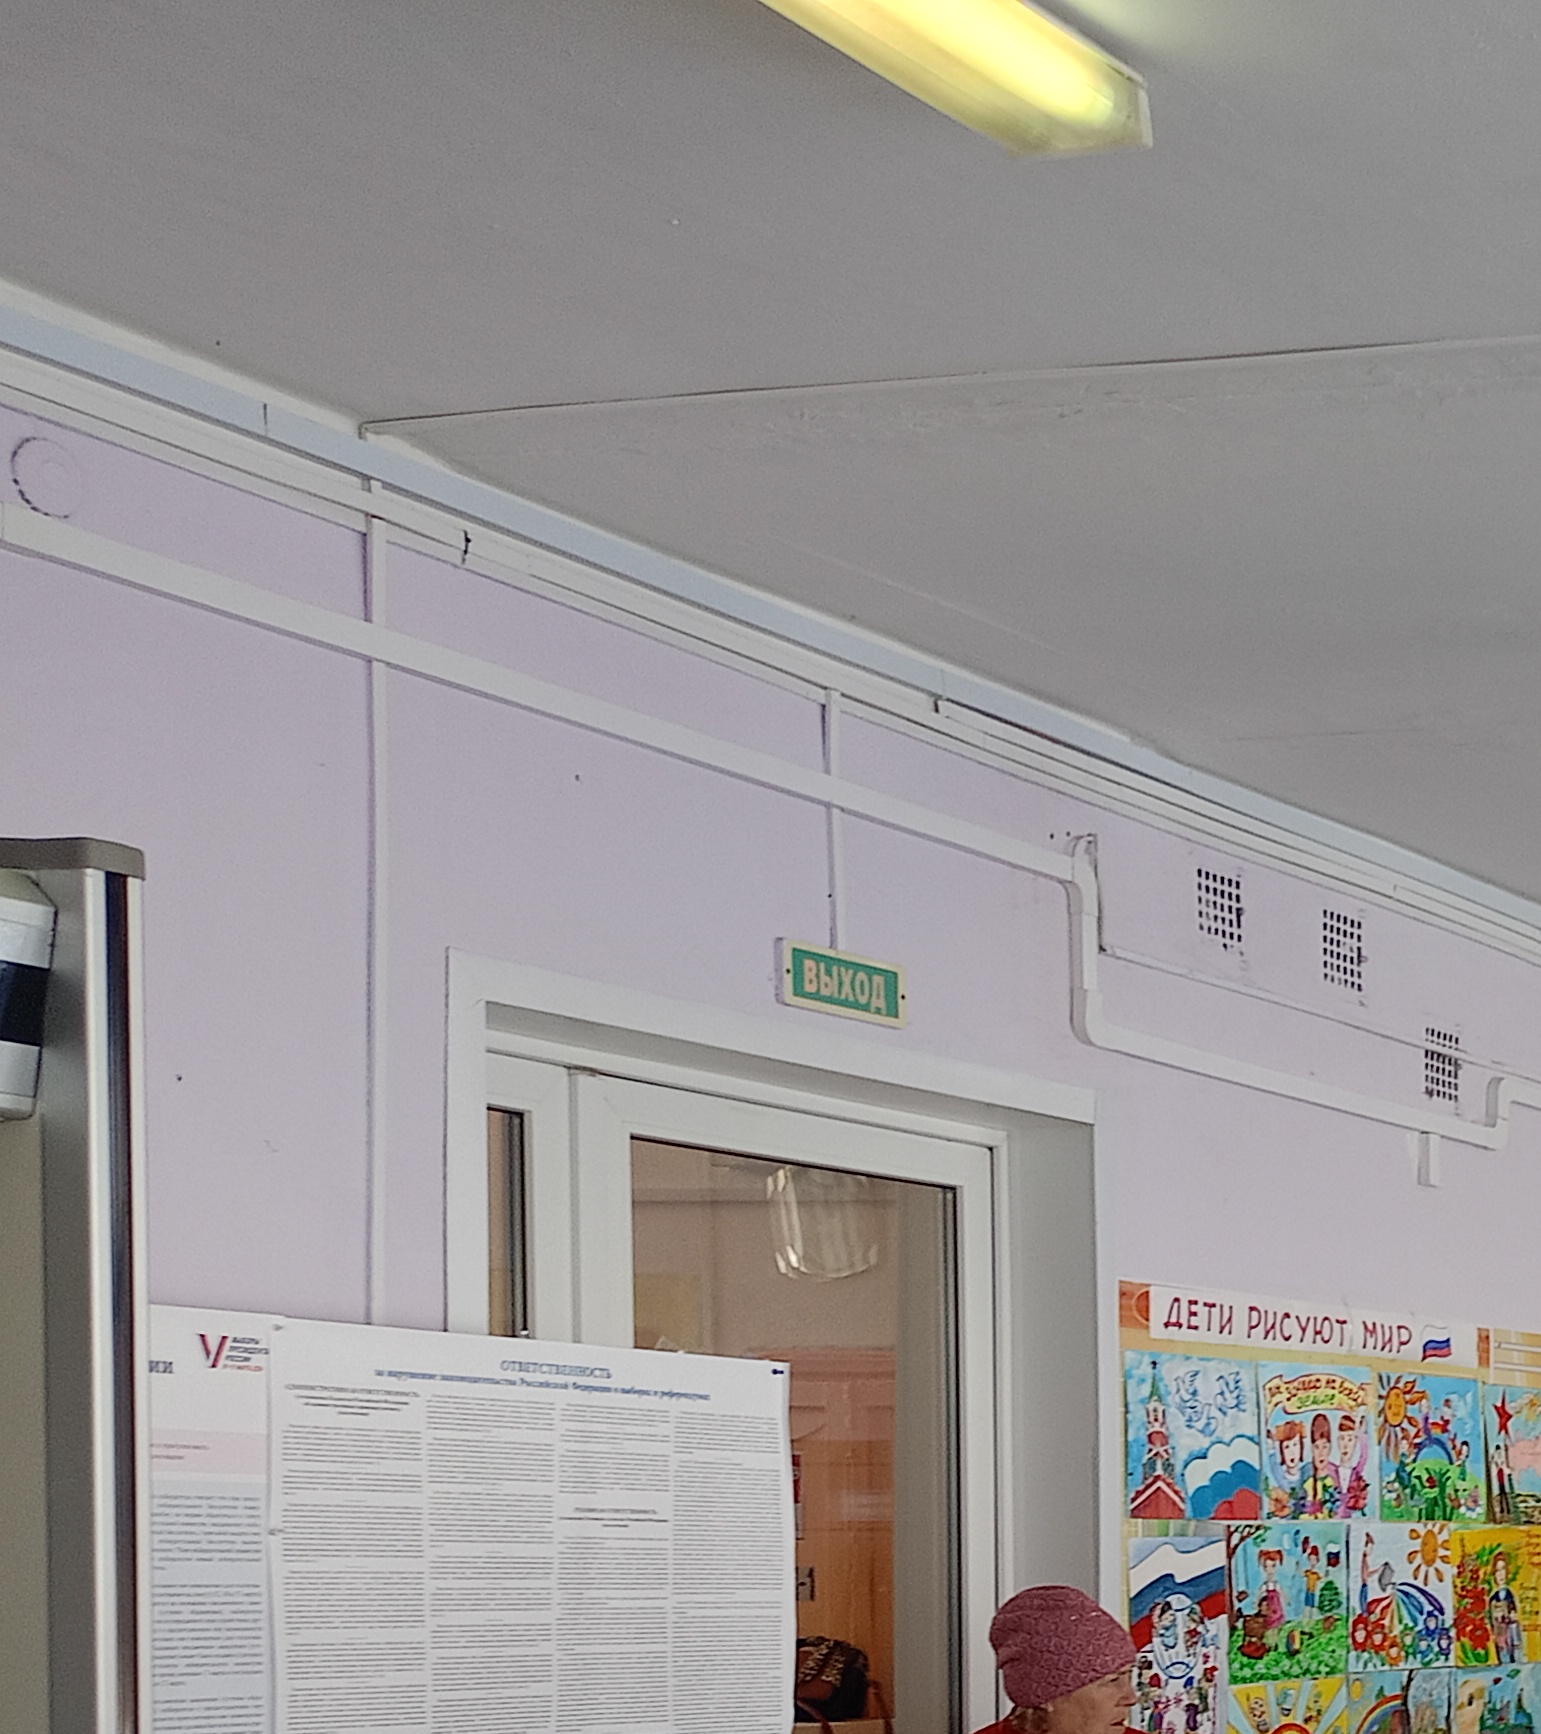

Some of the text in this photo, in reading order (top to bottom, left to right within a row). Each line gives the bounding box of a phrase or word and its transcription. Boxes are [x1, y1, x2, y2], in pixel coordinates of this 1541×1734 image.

[803, 958, 887, 1016] ВЫХОД
[1163, 1296, 1413, 1354] ДЕТИ РИСУЮТ МИР
